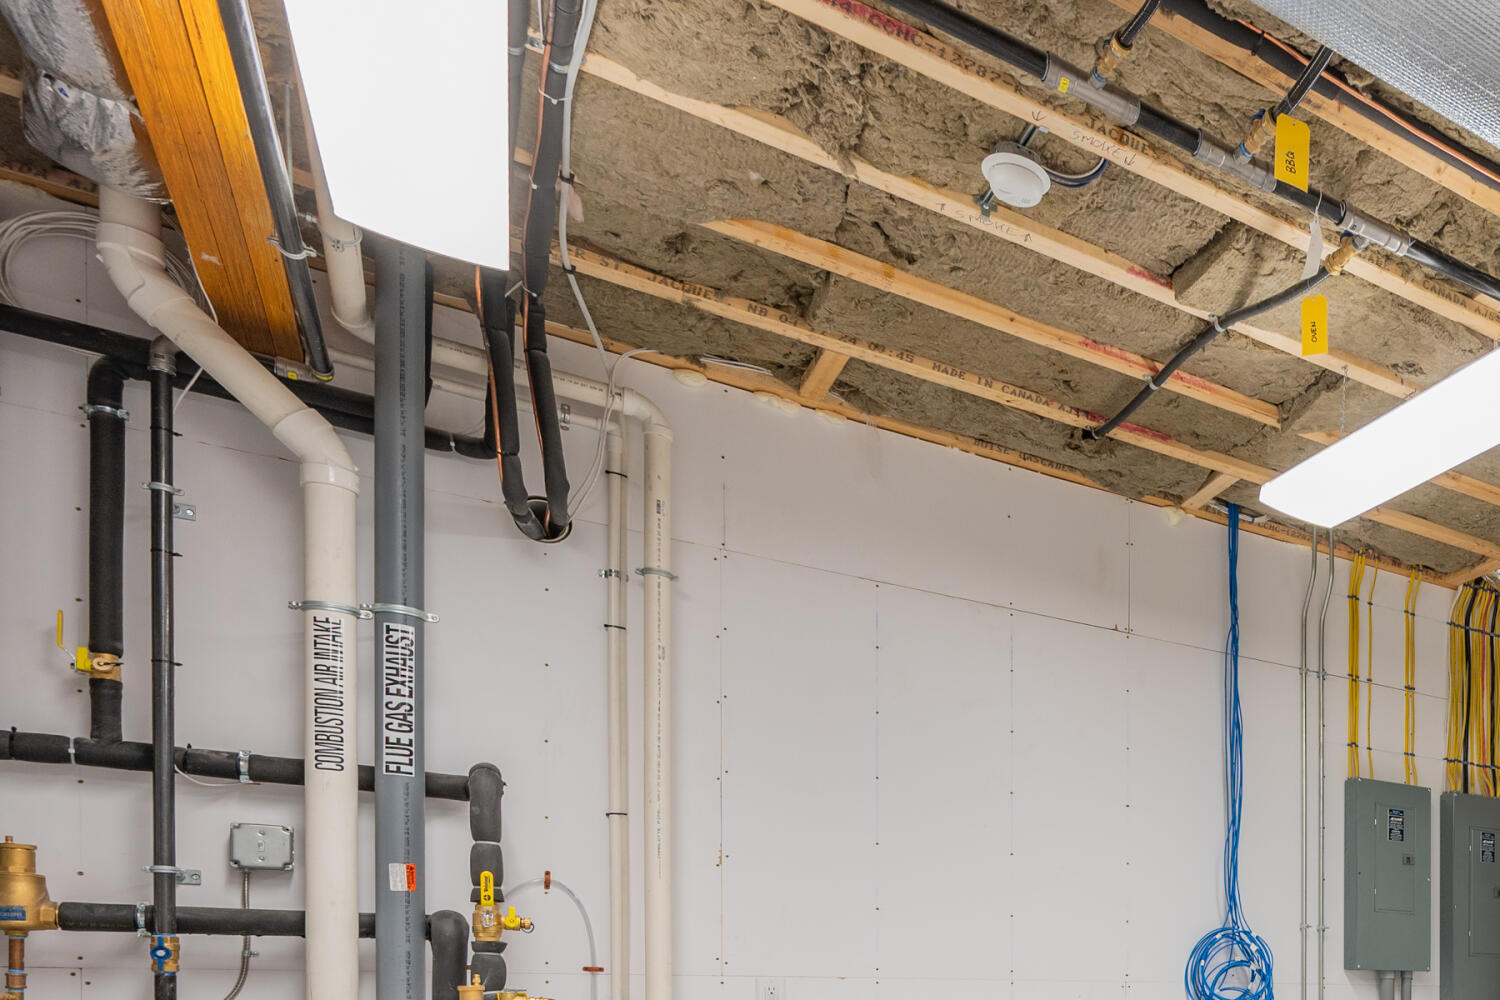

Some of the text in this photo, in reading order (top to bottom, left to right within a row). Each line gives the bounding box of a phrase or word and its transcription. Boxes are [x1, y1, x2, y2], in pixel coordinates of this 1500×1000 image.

[1071, 129, 1123, 158] SMOKE
[1422, 279, 1468, 309] CANADA
[1310, 320, 1318, 343] OVEN
[931, 362, 967, 380] MADE
[976, 375, 993, 389] IN
[1001, 384, 1051, 407] CANADA
[384, 624, 413, 699] EXHAUST
[313, 615, 345, 772] COMBUSTION AIR INTAKE
[384, 700, 414, 735] GAS
[384, 735, 413, 776] FLUE
